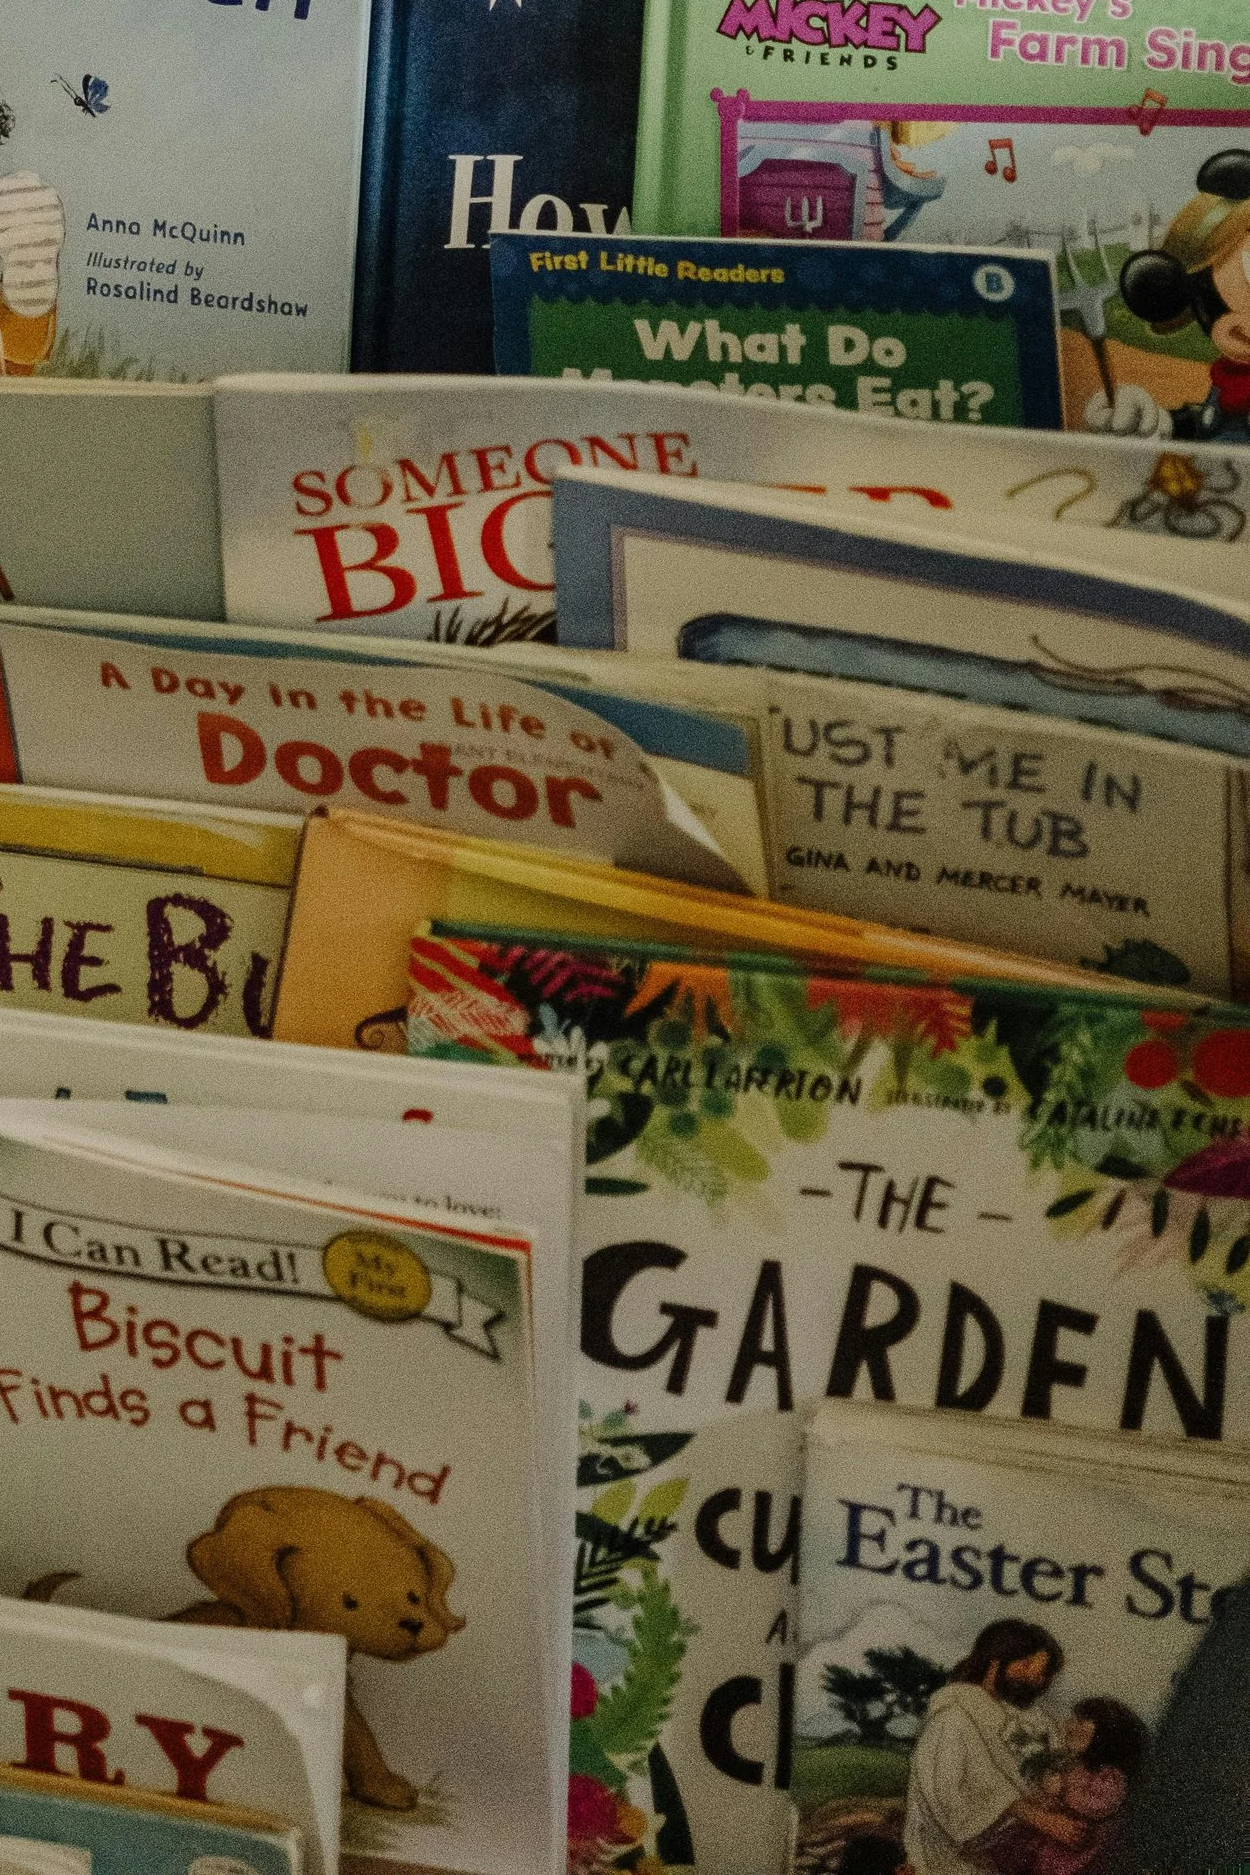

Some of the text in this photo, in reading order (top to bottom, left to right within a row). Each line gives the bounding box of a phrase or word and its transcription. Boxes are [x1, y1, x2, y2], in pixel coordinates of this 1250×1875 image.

[762, 44, 898, 71] FRIENDS
[988, 19, 1250, 85] Farm Sing
[86, 212, 246, 246] Anna McQuinn
[86, 251, 205, 281] Illustrated by
[86, 276, 308, 318] Rosalind Beardshaw
[529, 250, 786, 285] First Little Readers
[985, 271, 1002, 294] B
[633, 316, 908, 369] What Do
[856, 374, 995, 423] Eat?
[291, 431, 700, 517] SOMEONE
[100, 661, 132, 690] A
[150, 665, 246, 706] Day
[338, 688, 427, 721] the
[450, 696, 546, 740] Life
[570, 727, 615, 760] of
[196, 711, 604, 828] Doctor
[767, 705, 905, 768] UST
[1079, 759, 1143, 814] IN
[795, 776, 1089, 858] THE TUB
[785, 845, 1150, 918] GINA AND MERCER MAYER
[839, 1162, 956, 1234] THE
[11, 1208, 299, 1284] I Can Read!
[67, 1280, 343, 1393] Biscuit
[177, 1398, 217, 1434] a
[244, 1390, 451, 1506] Friend
[895, 1482, 983, 1531] The
[836, 1497, 1105, 1609] Easter
